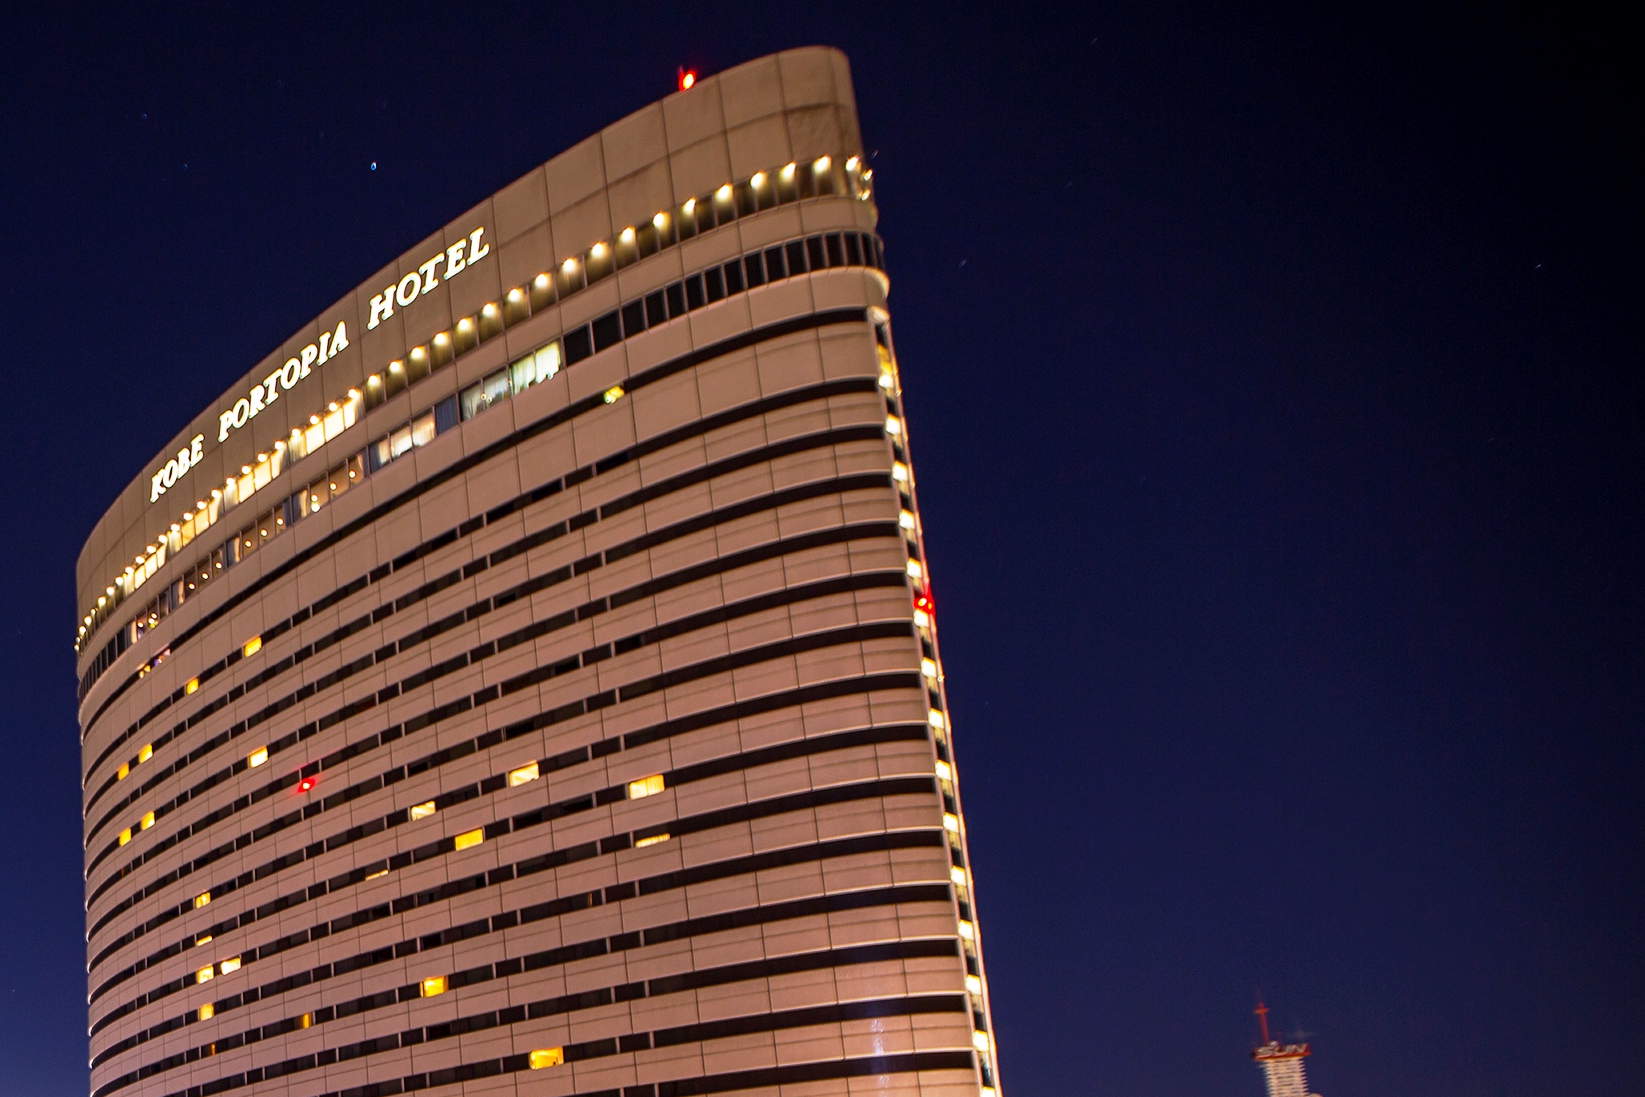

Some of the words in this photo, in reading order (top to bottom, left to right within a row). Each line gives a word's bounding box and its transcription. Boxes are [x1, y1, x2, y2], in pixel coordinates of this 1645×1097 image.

[150, 433, 205, 503] KOBE
[218, 321, 349, 443] PORTOPIA
[367, 226, 491, 331] HOTEL
